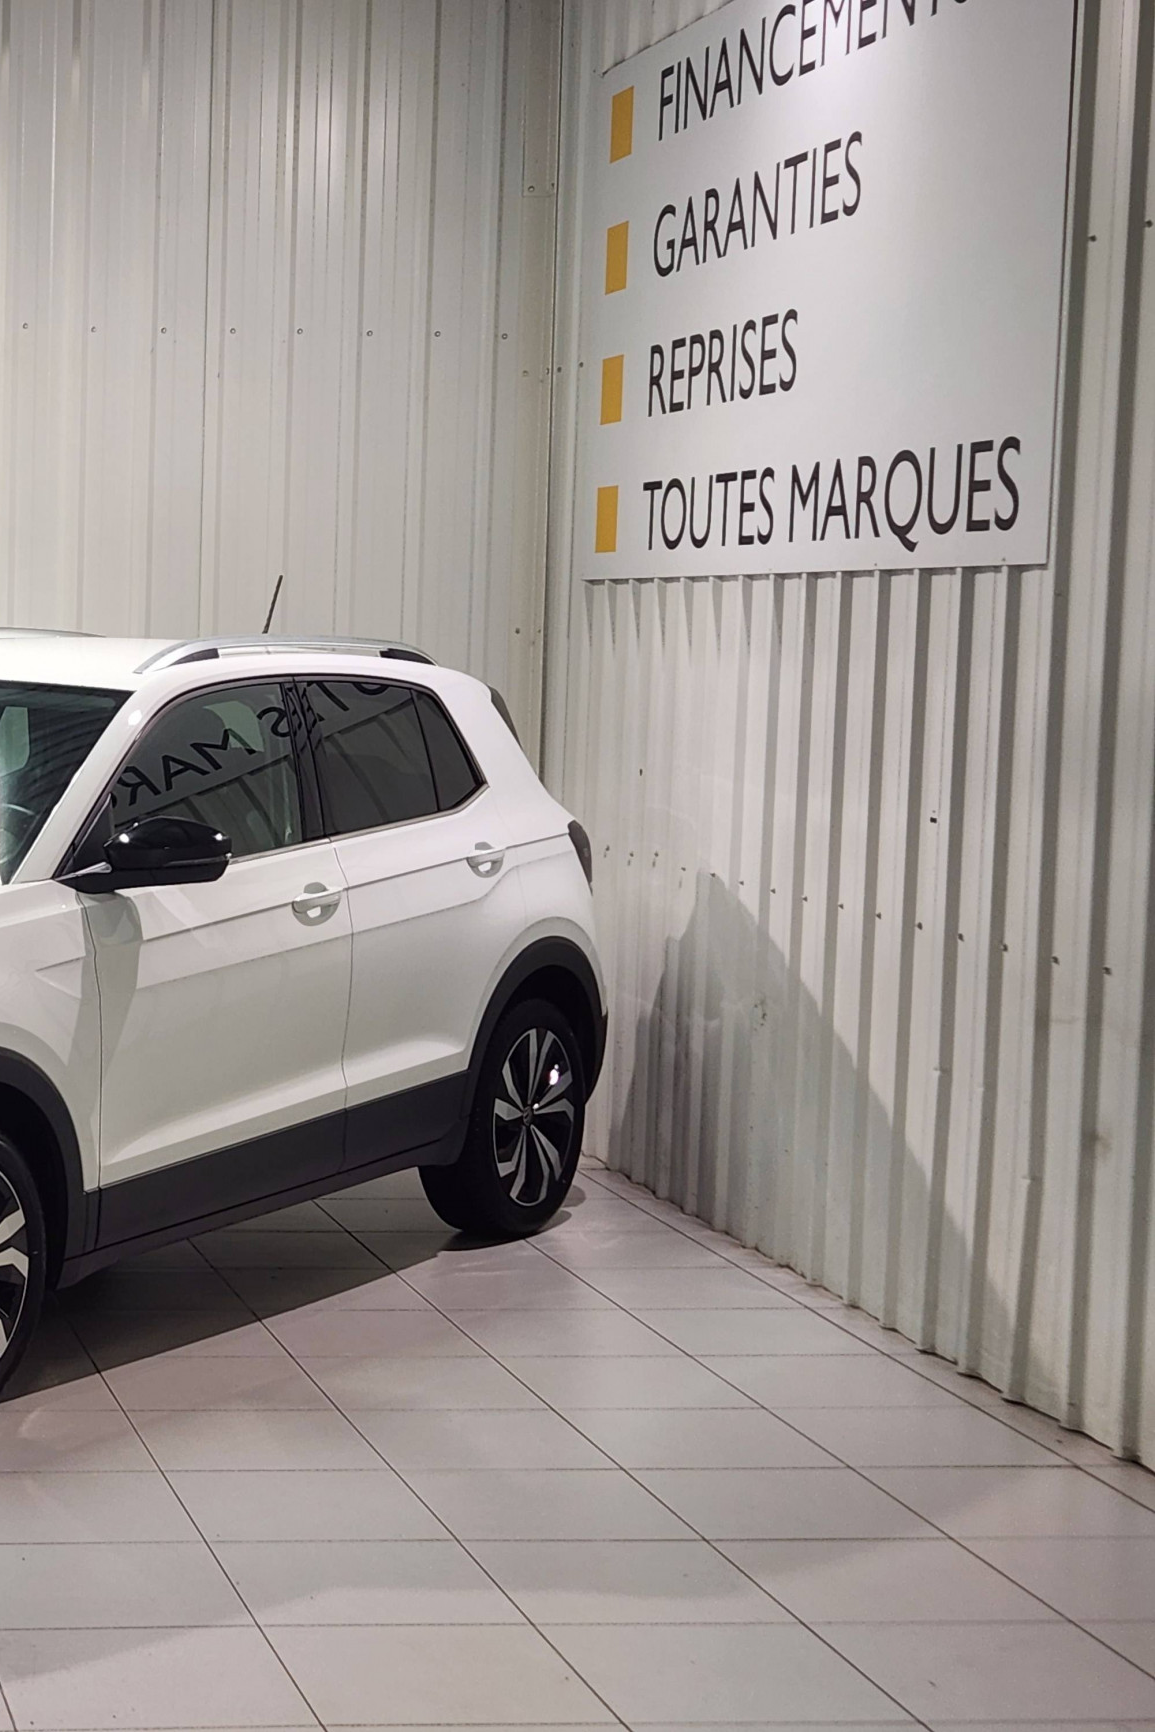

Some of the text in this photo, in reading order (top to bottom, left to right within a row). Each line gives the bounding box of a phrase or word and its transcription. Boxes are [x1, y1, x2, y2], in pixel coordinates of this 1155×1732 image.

[658, 0, 967, 141] FINANCEME
[653, 131, 862, 277] GARANTIES
[648, 309, 798, 418] REPRISES
[643, 436, 1021, 553] TOUTES MARQUES
